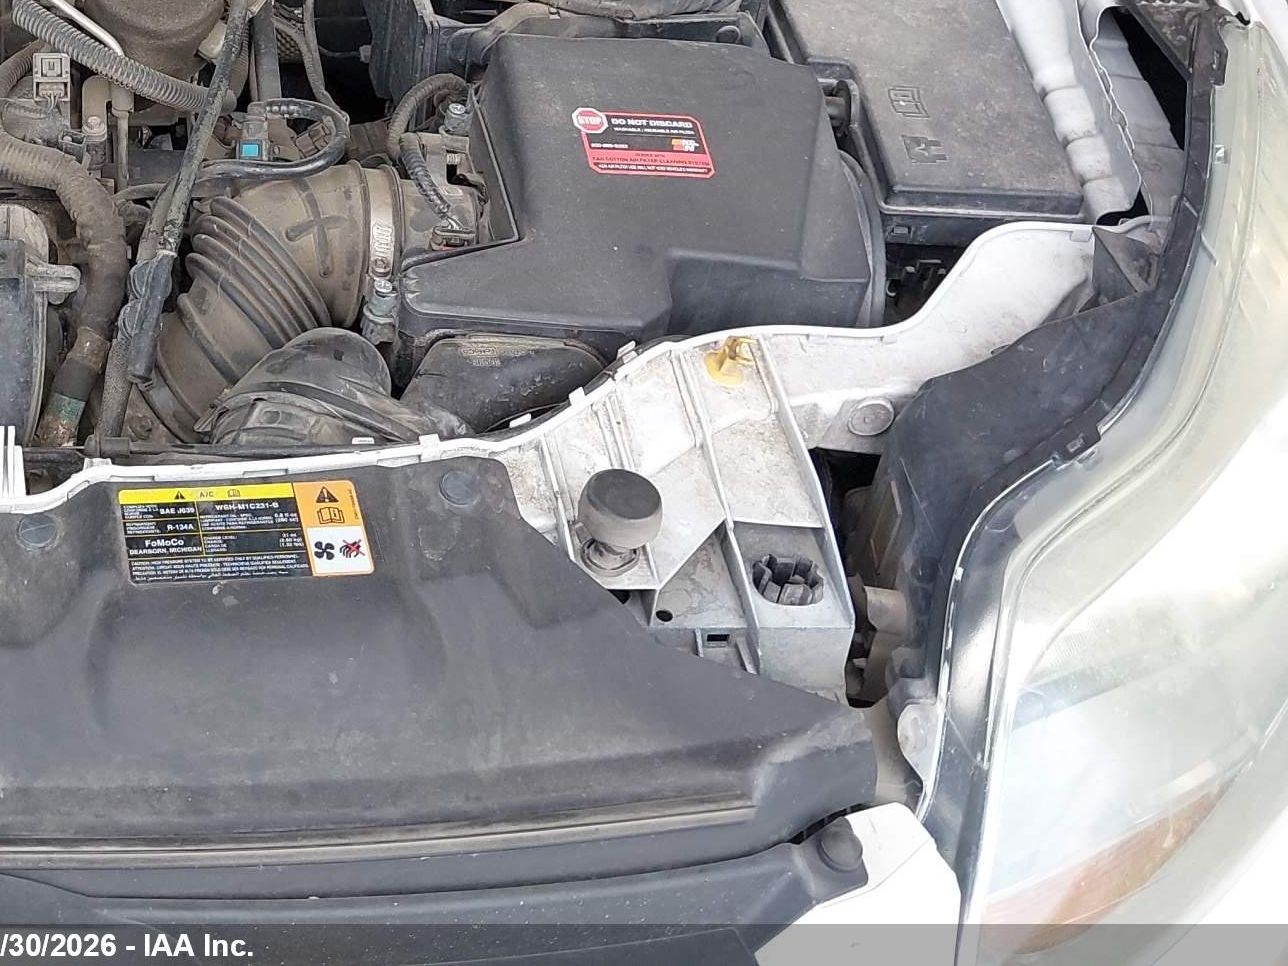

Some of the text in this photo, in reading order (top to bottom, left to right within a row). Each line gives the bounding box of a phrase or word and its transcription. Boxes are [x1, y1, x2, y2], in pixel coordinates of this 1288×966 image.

[578, 115, 602, 125] STOP
[628, 118, 647, 126] NOT
[649, 120, 693, 128] DISCARD
[145, 538, 184, 547] FoMoCo
